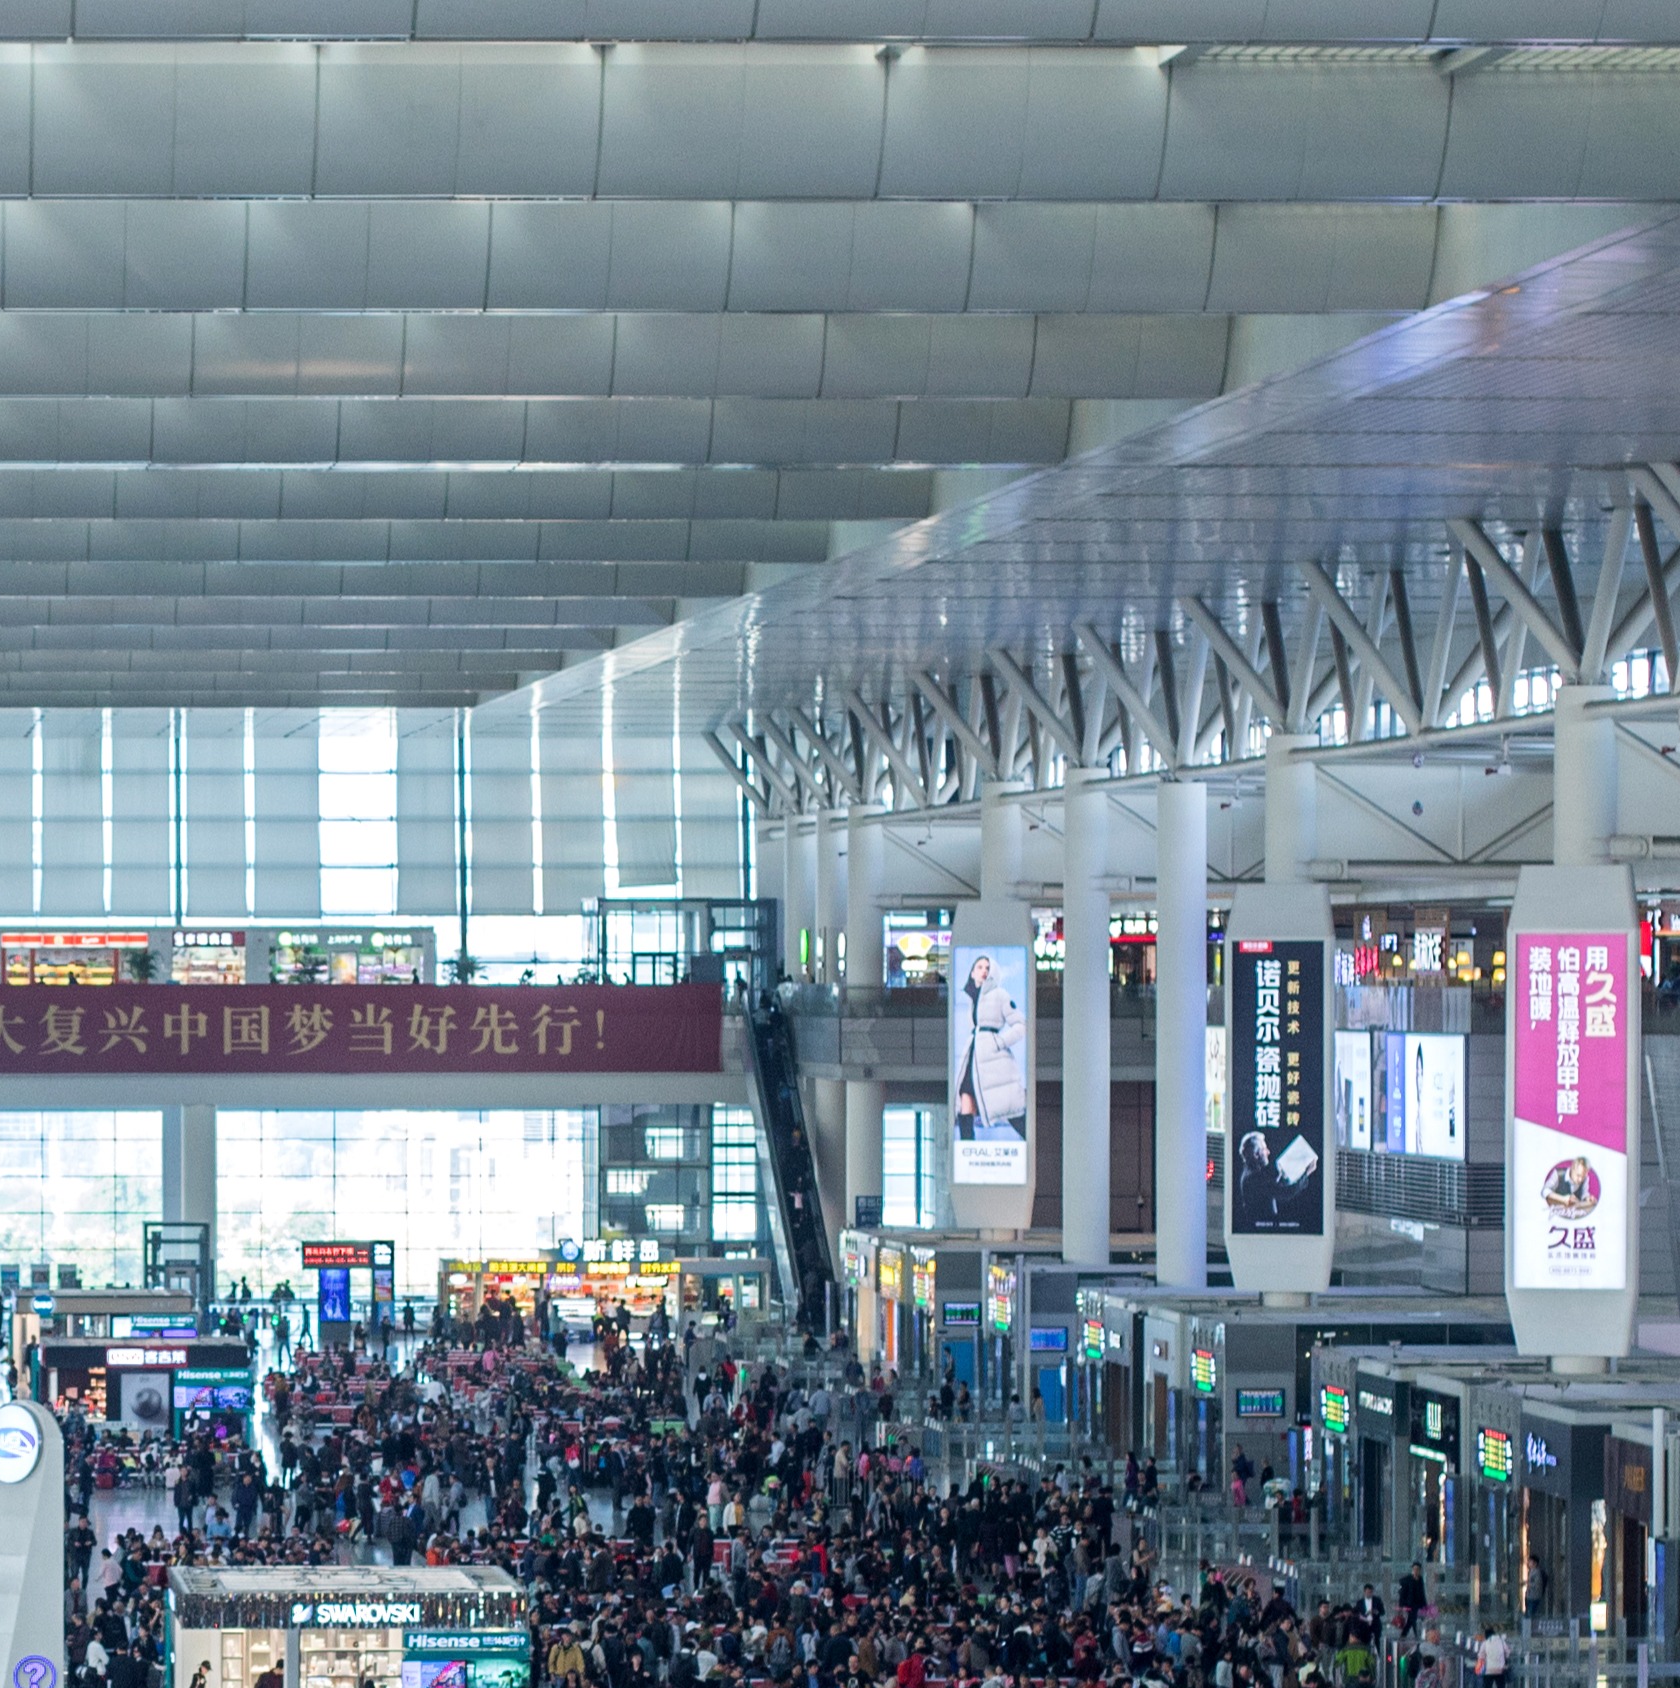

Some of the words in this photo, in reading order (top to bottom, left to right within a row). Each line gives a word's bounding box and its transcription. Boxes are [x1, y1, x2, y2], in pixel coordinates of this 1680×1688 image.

[1287, 960, 1300, 1035] 更新技术
[1584, 946, 1617, 1037] 用久盛
[1254, 959, 1281, 1128] 诺贝尔瓷抛砖
[1287, 1052, 1300, 1127] 更好瓷砖
[1547, 1226, 1596, 1250] 久盛
[174, 1370, 219, 1380] Hisense
[317, 1604, 420, 1623] SWAROVSKI
[408, 1635, 480, 1648] Hisense
